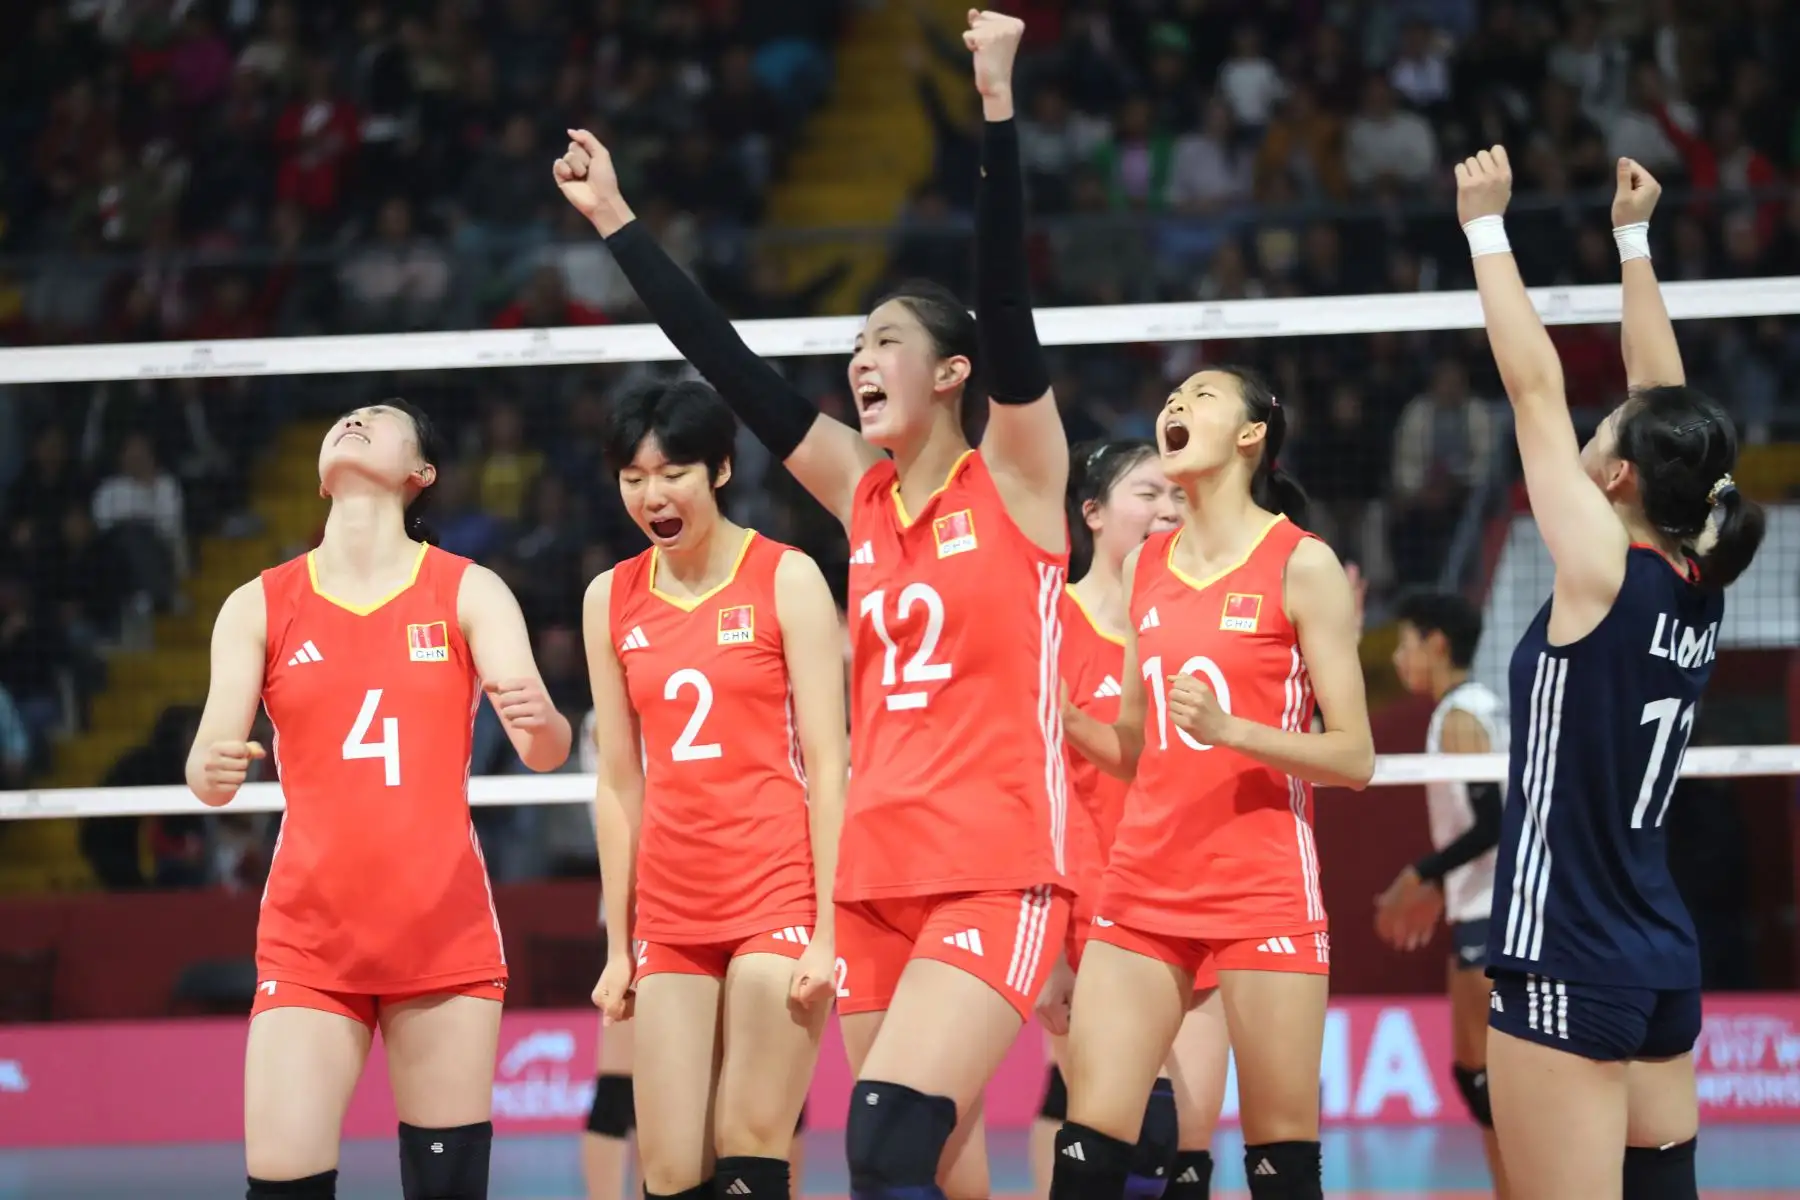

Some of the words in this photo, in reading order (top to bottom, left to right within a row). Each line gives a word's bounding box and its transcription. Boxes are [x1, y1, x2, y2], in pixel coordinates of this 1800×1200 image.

[943, 537, 971, 554] CHN
[722, 630, 749, 641] CHN
[860, 582, 952, 686] 12
[1225, 618, 1253, 629] CHN
[415, 648, 445, 659] CHN
[664, 668, 722, 762] 2
[1141, 655, 1232, 751] 10
[342, 688, 401, 787] 4
